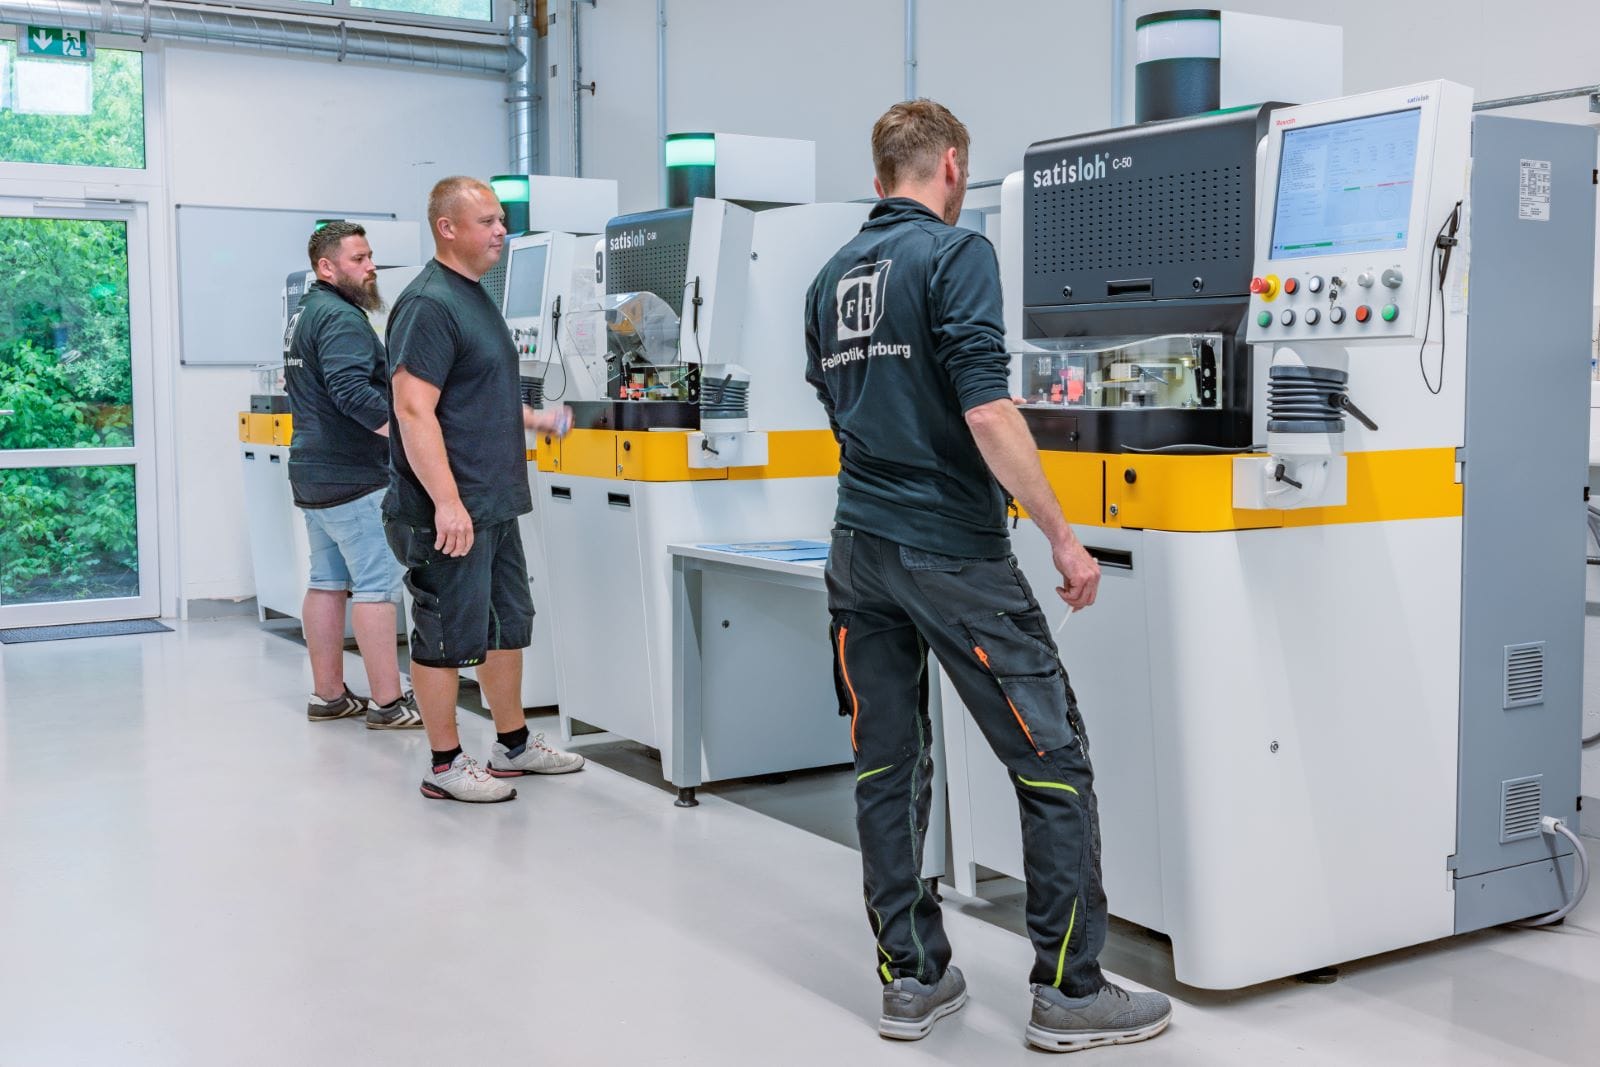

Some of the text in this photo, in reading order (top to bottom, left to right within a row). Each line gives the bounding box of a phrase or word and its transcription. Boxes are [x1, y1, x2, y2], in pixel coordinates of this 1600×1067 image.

[1033, 154, 1132, 188] satisloh C-50
[609, 229, 645, 251] satisloh
[596, 251, 603, 284] 9
